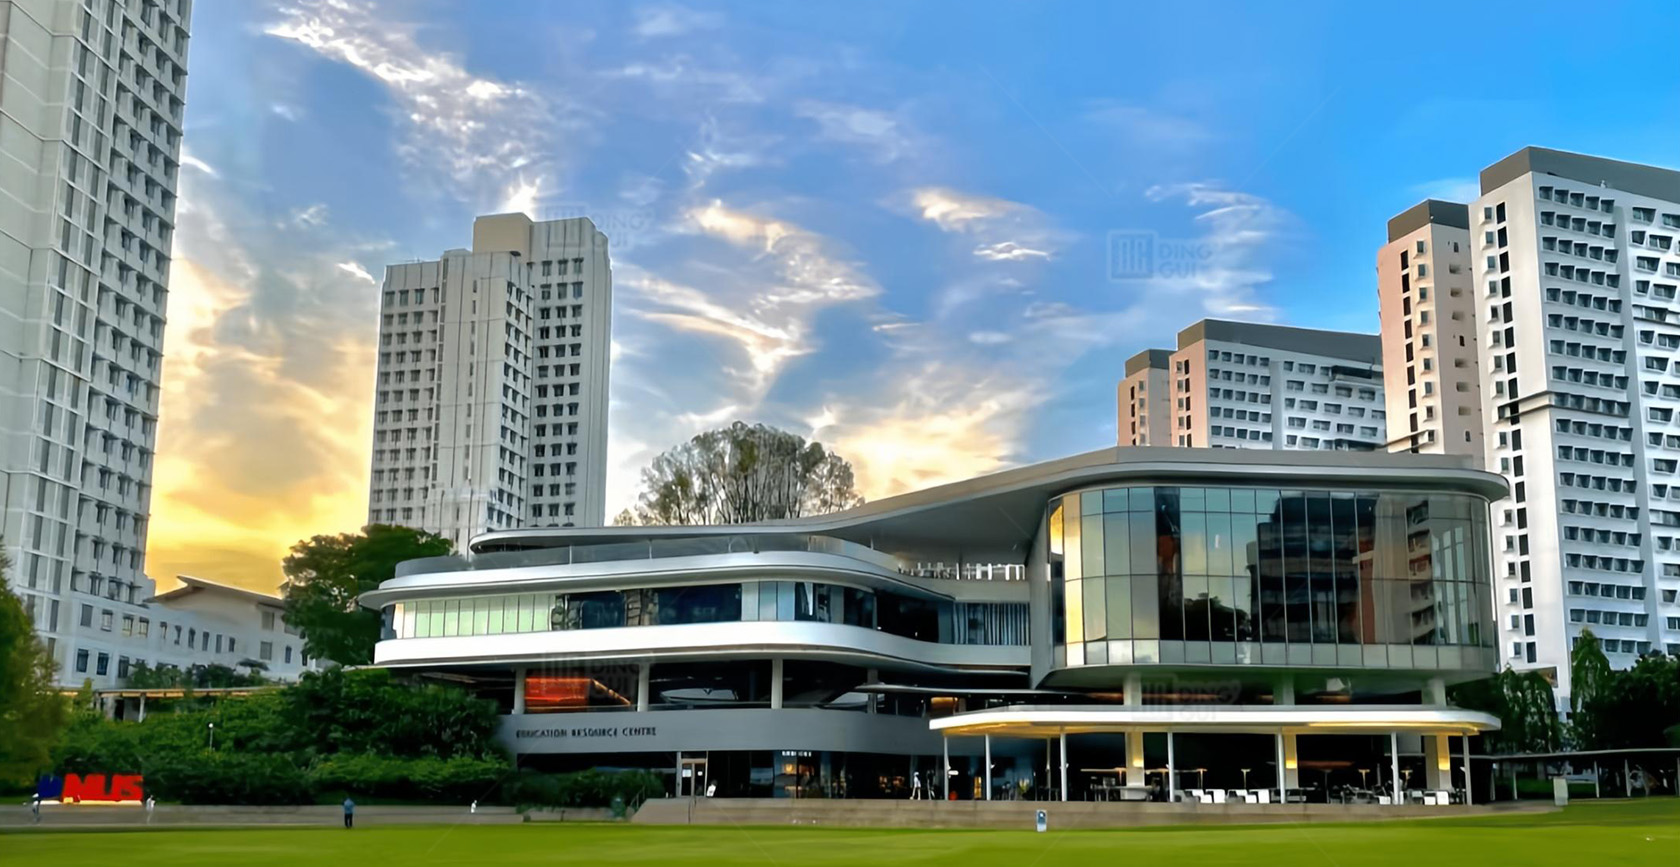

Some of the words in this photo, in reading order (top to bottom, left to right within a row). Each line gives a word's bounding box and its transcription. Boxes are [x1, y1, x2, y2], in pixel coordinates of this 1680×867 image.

[516, 728, 567, 739] EDUCATION
[571, 727, 618, 738] RESOURCE
[622, 726, 657, 737] CENTRE
[62, 772, 143, 802] NUS
